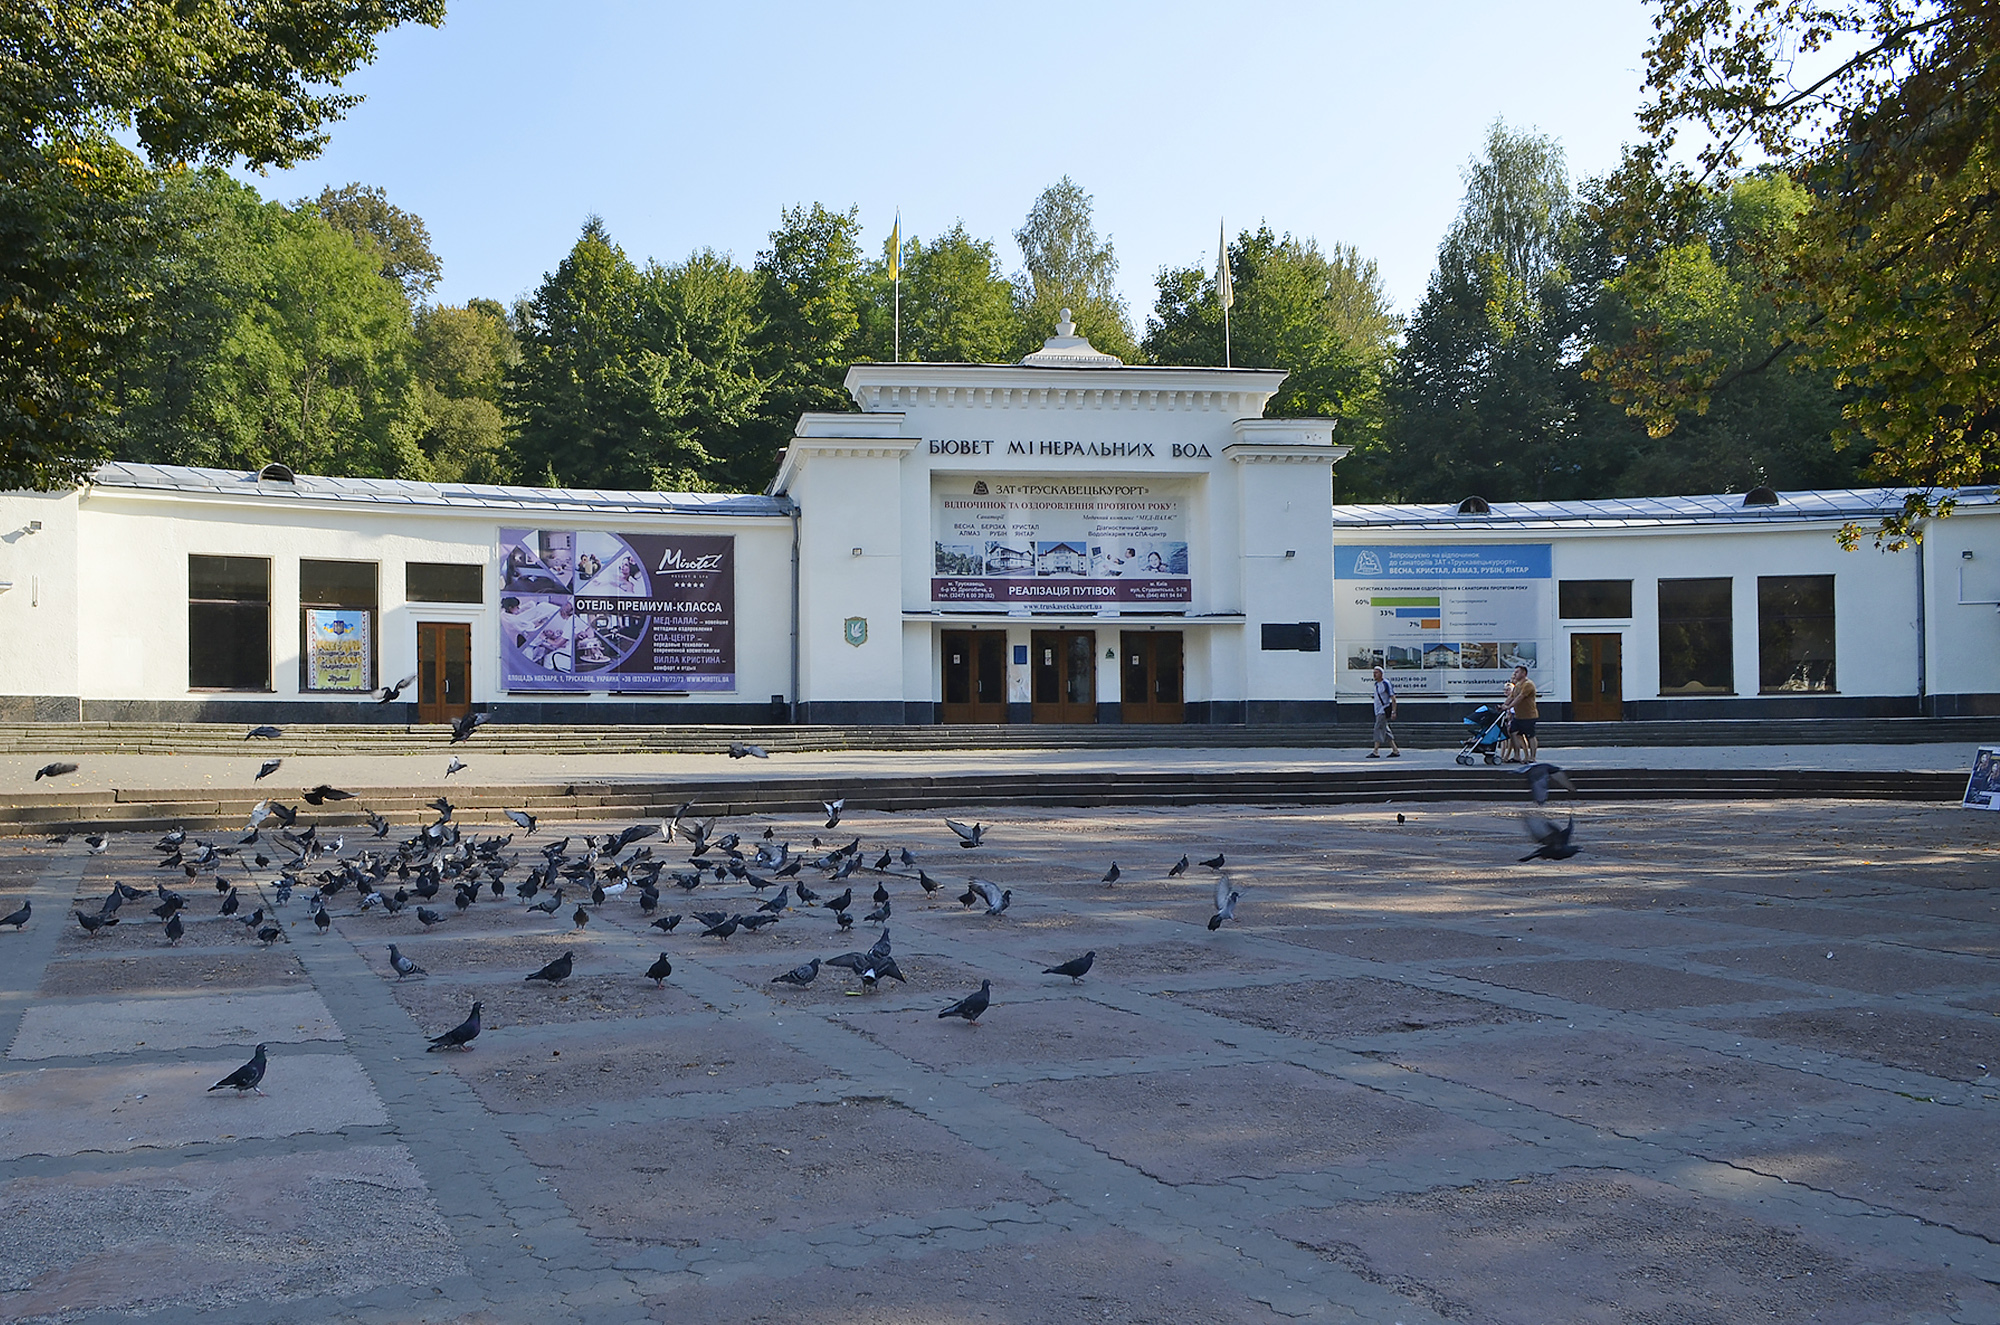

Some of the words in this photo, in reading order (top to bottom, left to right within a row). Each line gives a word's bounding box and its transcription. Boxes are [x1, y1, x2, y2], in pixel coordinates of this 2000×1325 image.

[929, 440, 994, 455] БЮВЕТ
[1007, 440, 1155, 457] МІНЕРАЛЬНИХ
[1172, 443, 1212, 458] ВОД
[996, 485, 1016, 495] ЗАТ
[1017, 485, 1149, 496] «ТРУСКАВЕЦЬКУРОРТ»
[944, 501, 1006, 510] ВІДПОЧИНОК
[1021, 502, 1094, 510] ОЗДОРОВЛЕННЯ
[657, 549, 722, 572] Mirotel
[1008, 586, 1070, 596] РЕАЛІЗАЦІЯ
[1072, 586, 1116, 596] ПУТІВОК
[576, 600, 614, 611] ОТЕЛЬ
[617, 601, 722, 612] ПРЕМИУМ-КЛАССА
[1023, 603, 1102, 611] www.truskavetskurort.ua
[653, 617, 698, 625] МЕД-ПАЛАС
[653, 634, 695, 642] СПА-ЦЕНТР
[654, 656, 680, 664] ВИЛЛА
[681, 656, 720, 664] КРИСТИНА
[508, 675, 534, 683] ПЛОЩАДЬ
